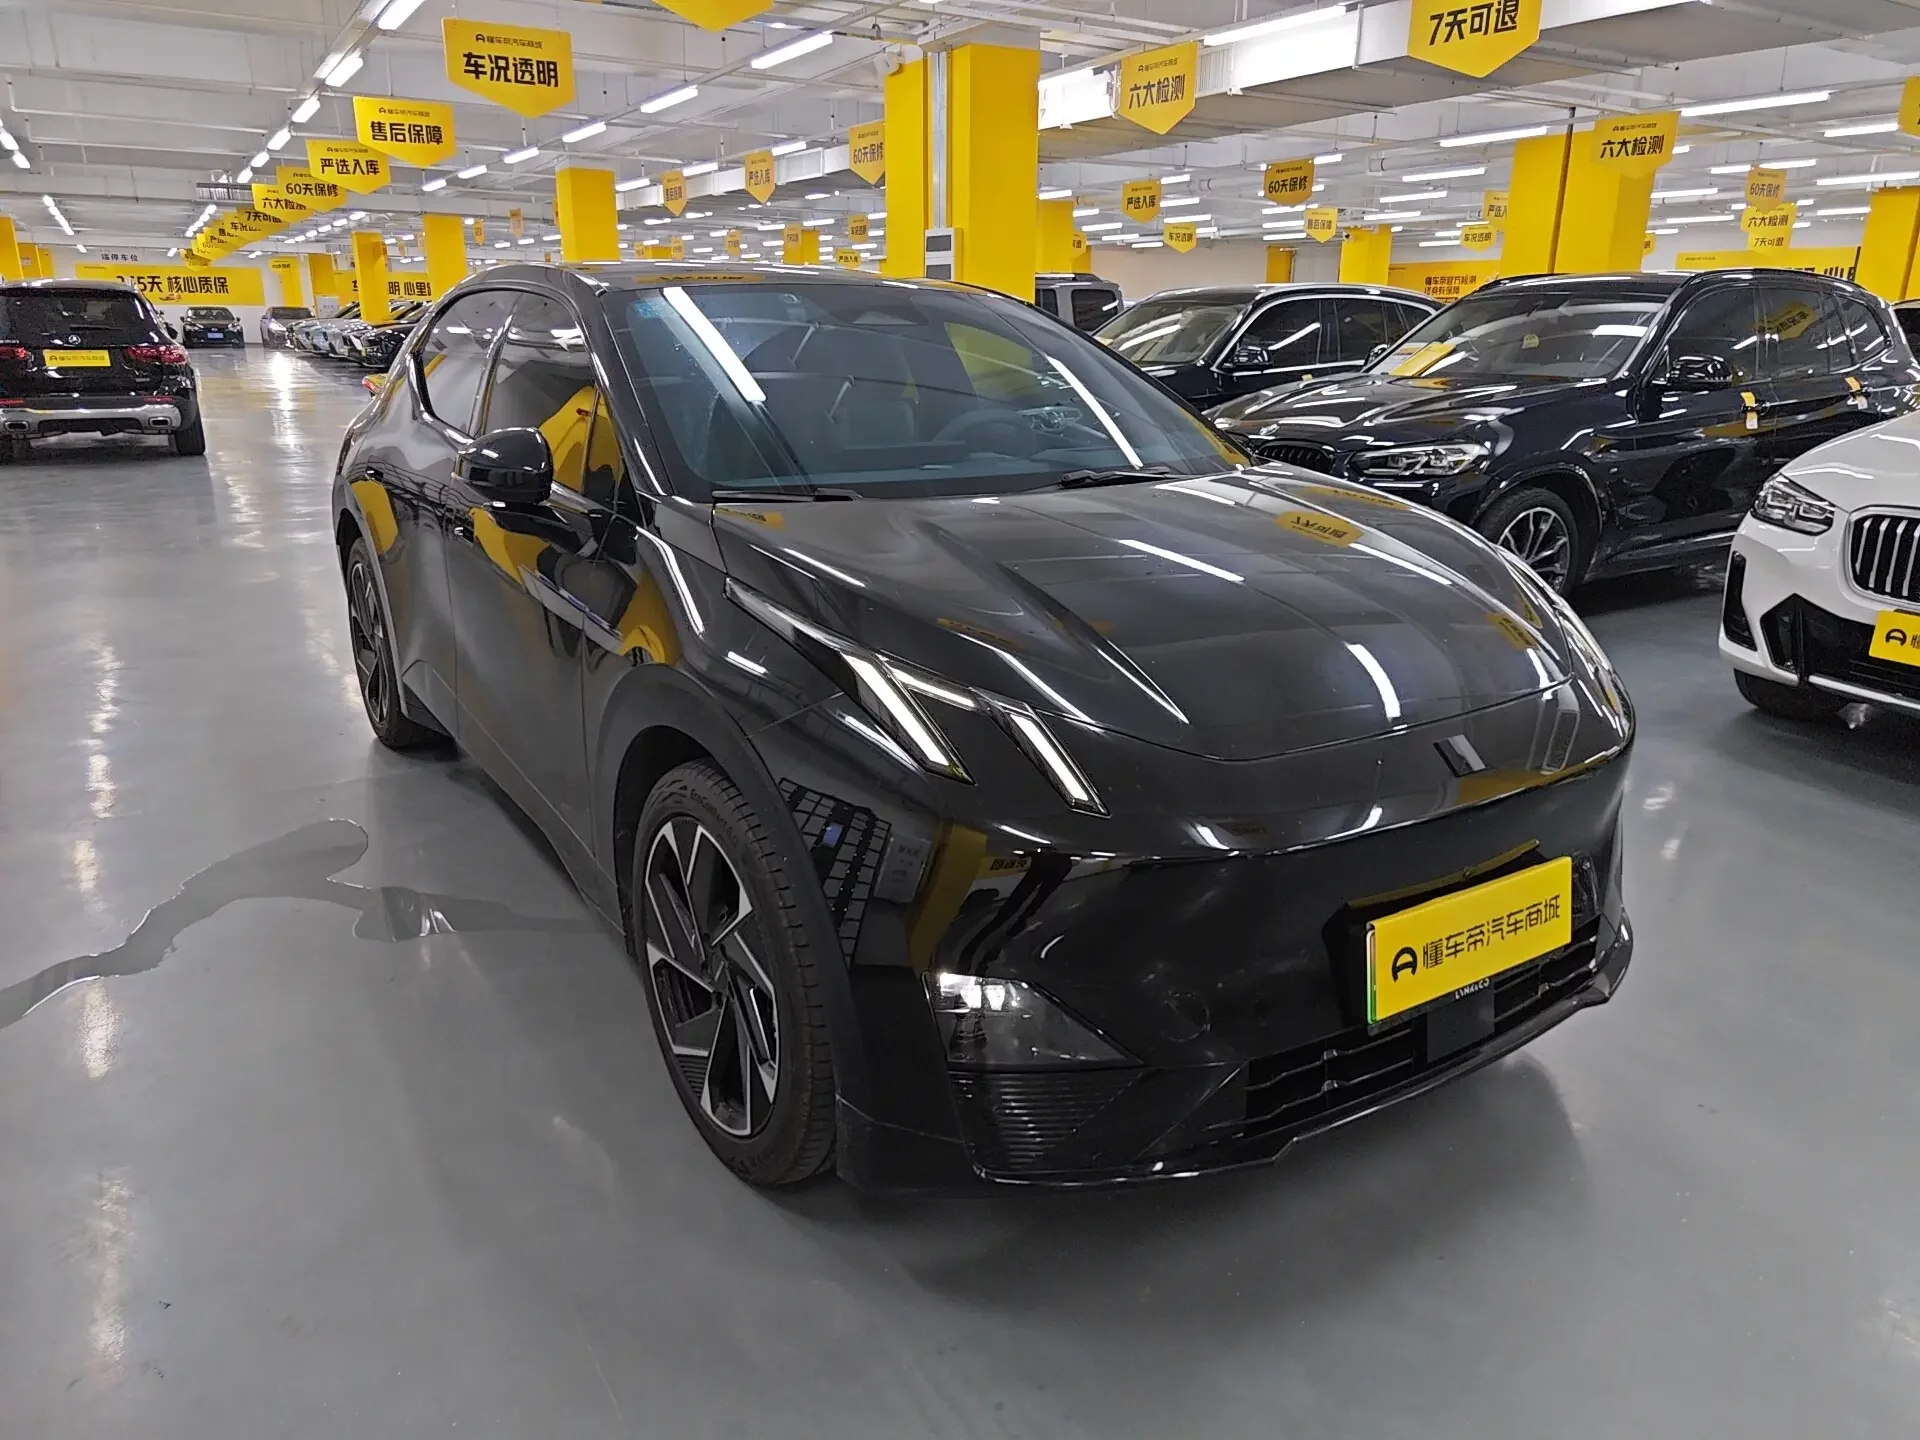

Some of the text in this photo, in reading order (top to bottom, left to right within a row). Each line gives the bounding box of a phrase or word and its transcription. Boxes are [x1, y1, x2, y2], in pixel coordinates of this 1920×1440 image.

[1429, 0, 1519, 46] 7天可退
[463, 52, 559, 87] 车况透明
[1129, 74, 1186, 109] 六大检测
[370, 120, 443, 145] 售后保障
[1600, 134, 1665, 159] 六大检测
[320, 158, 380, 176] 严选入库
[285, 182, 340, 197] 60天保修
[1268, 176, 1308, 194] 60天保修
[1750, 183, 1780, 199] 60天保修
[1126, 194, 1156, 210] 严选入库
[1487, 204, 1508, 218] 严选入
[1748, 215, 1789, 228] 六大检测
[167, 275, 230, 294] 核心质保
